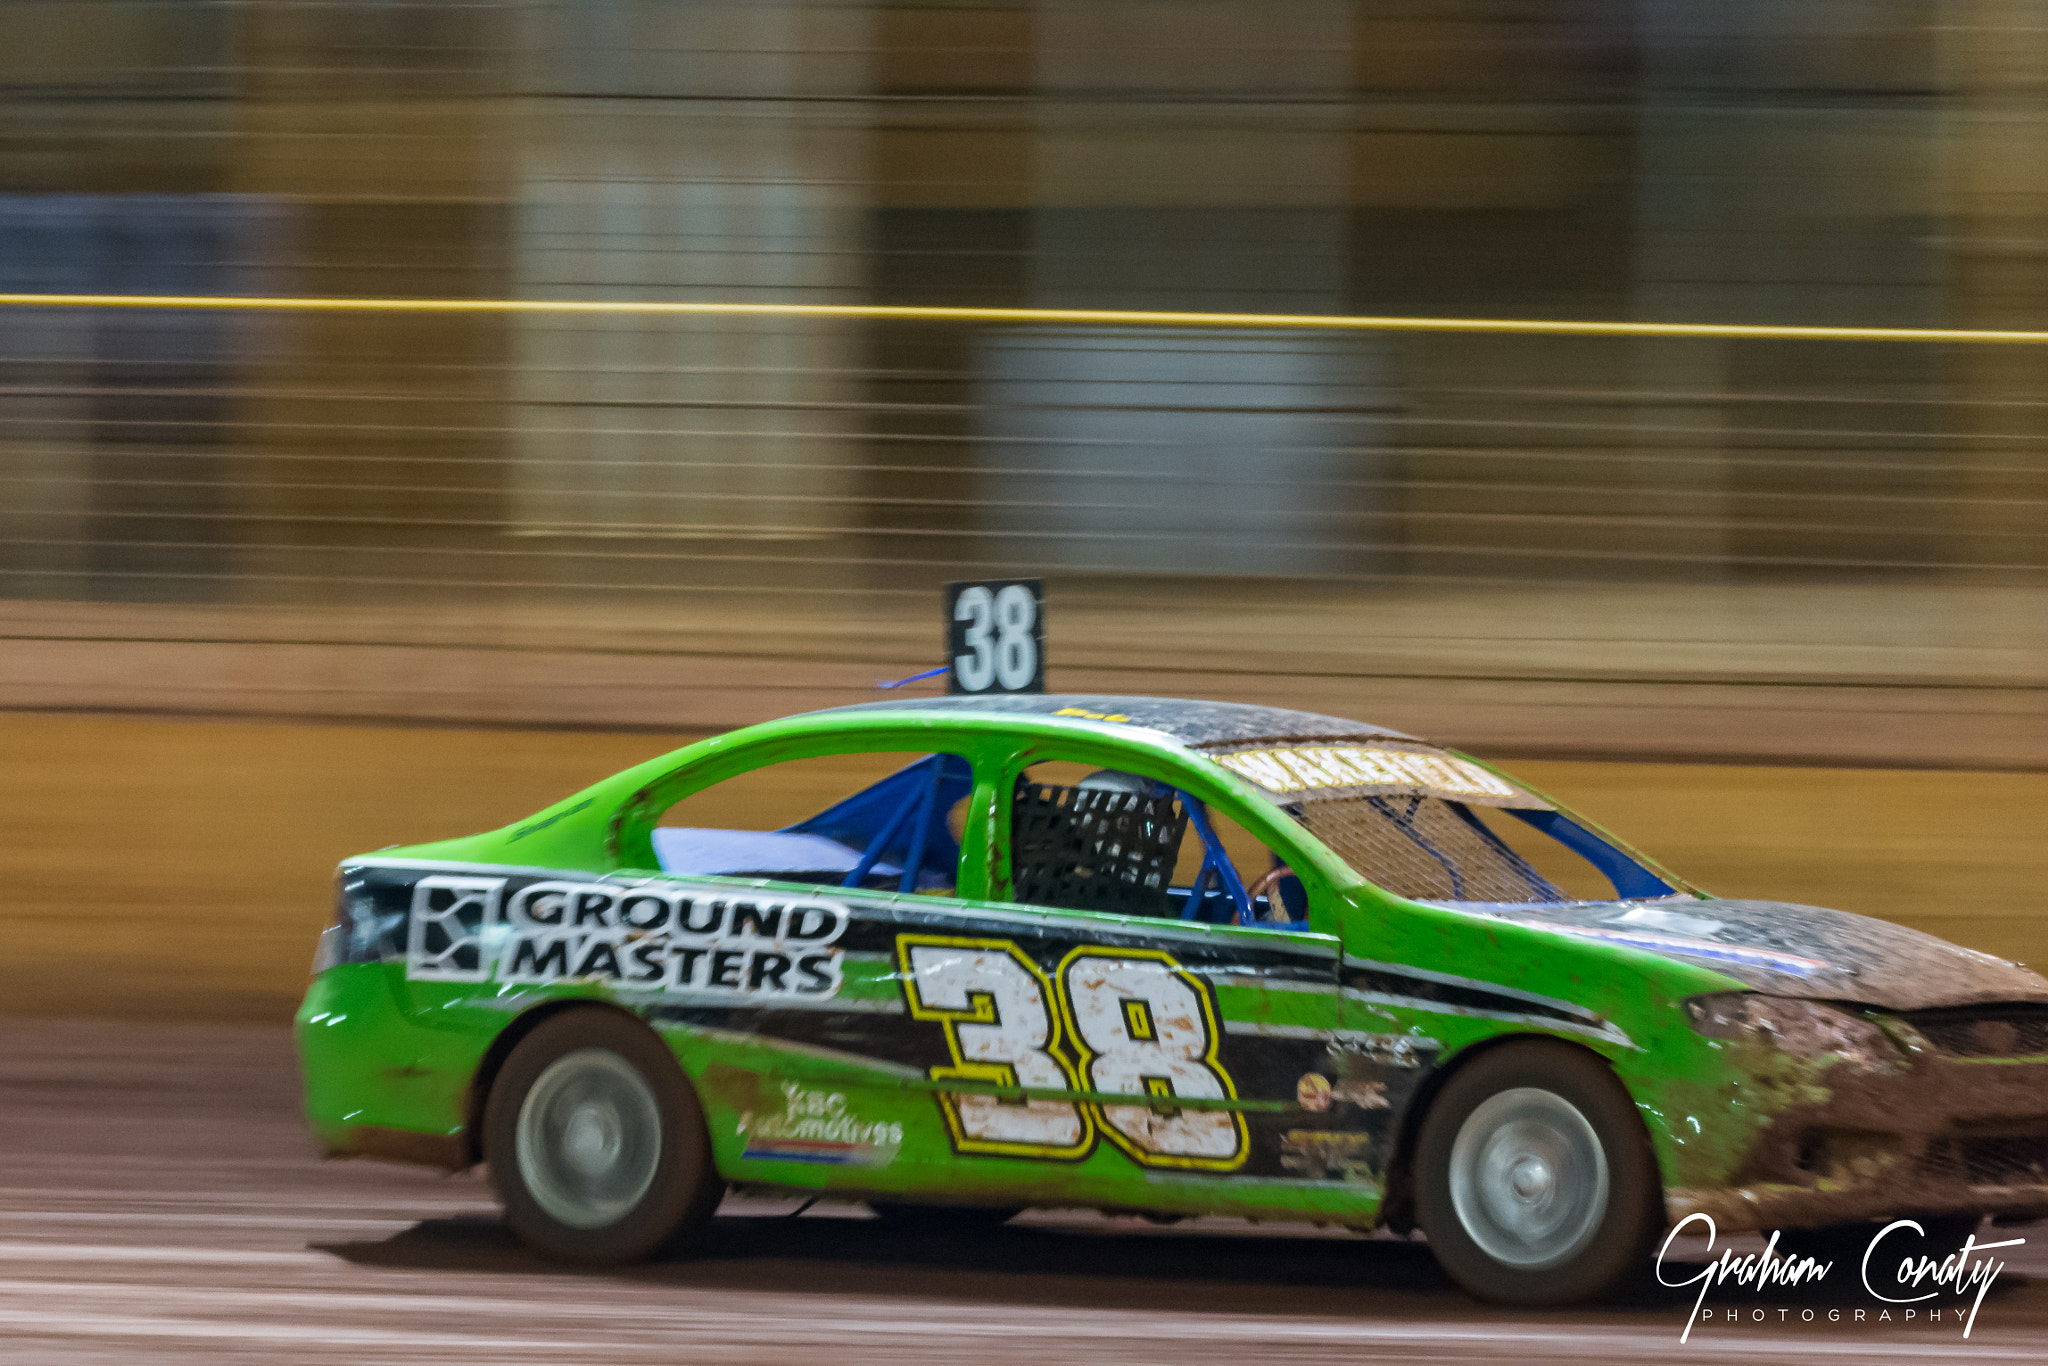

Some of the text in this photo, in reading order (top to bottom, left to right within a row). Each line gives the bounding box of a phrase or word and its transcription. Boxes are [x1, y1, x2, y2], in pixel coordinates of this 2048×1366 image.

[953, 584, 1039, 692] 38
[519, 887, 845, 942] GROUND
[507, 933, 838, 995] MASTERS
[896, 932, 1251, 1171] 38
